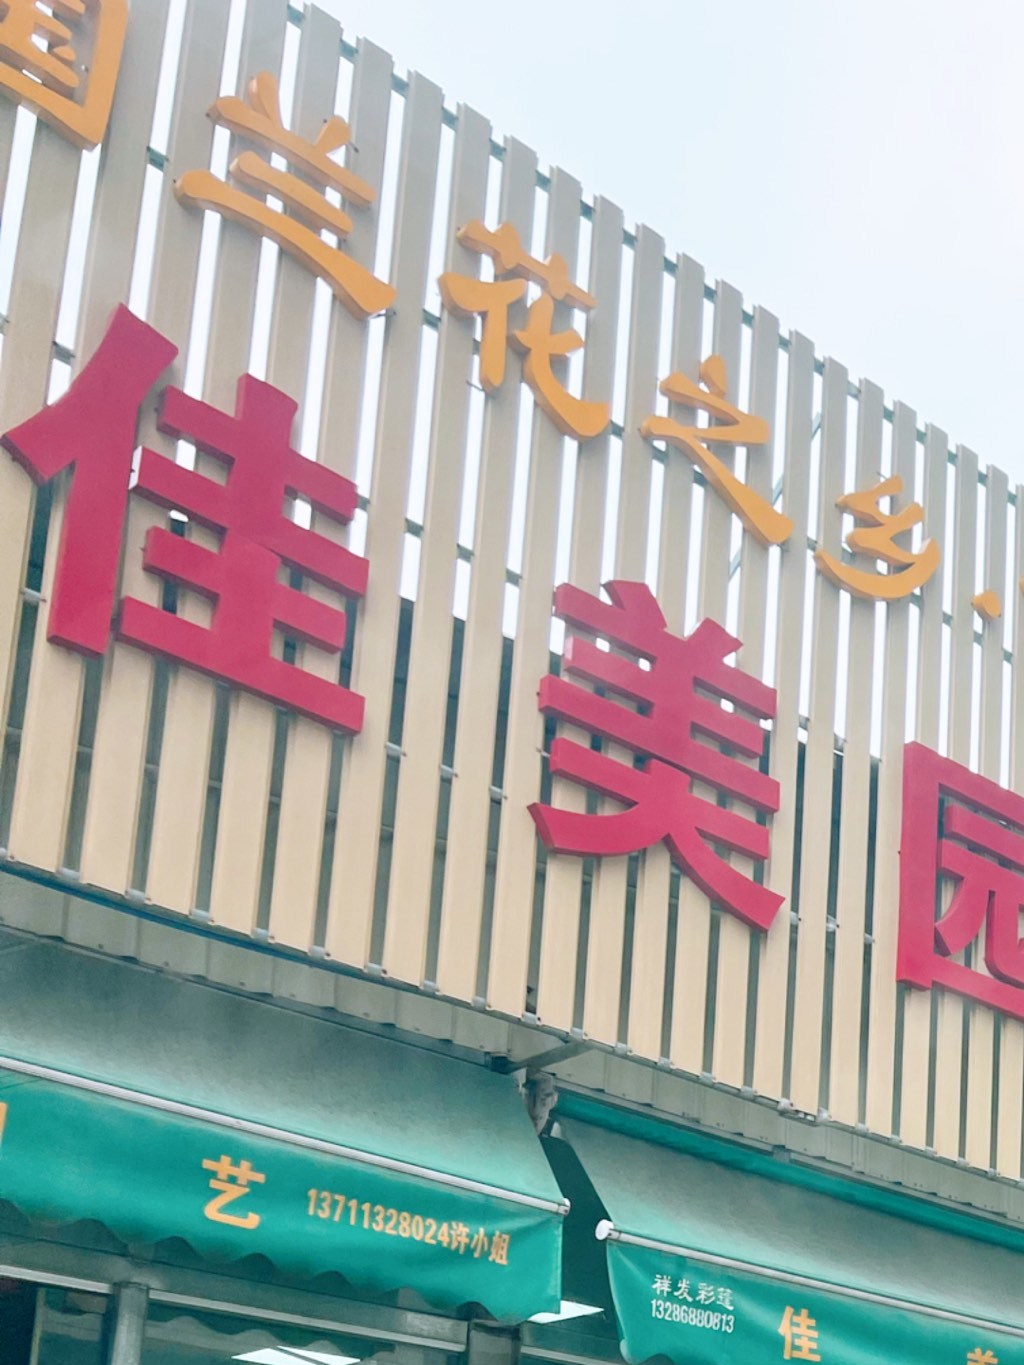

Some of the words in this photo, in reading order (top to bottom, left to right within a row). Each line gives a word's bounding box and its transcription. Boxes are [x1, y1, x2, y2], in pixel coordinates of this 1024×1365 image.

[307, 1188, 511, 1266] 13711328024许小姐
[651, 1298, 735, 1333] 13286880813
